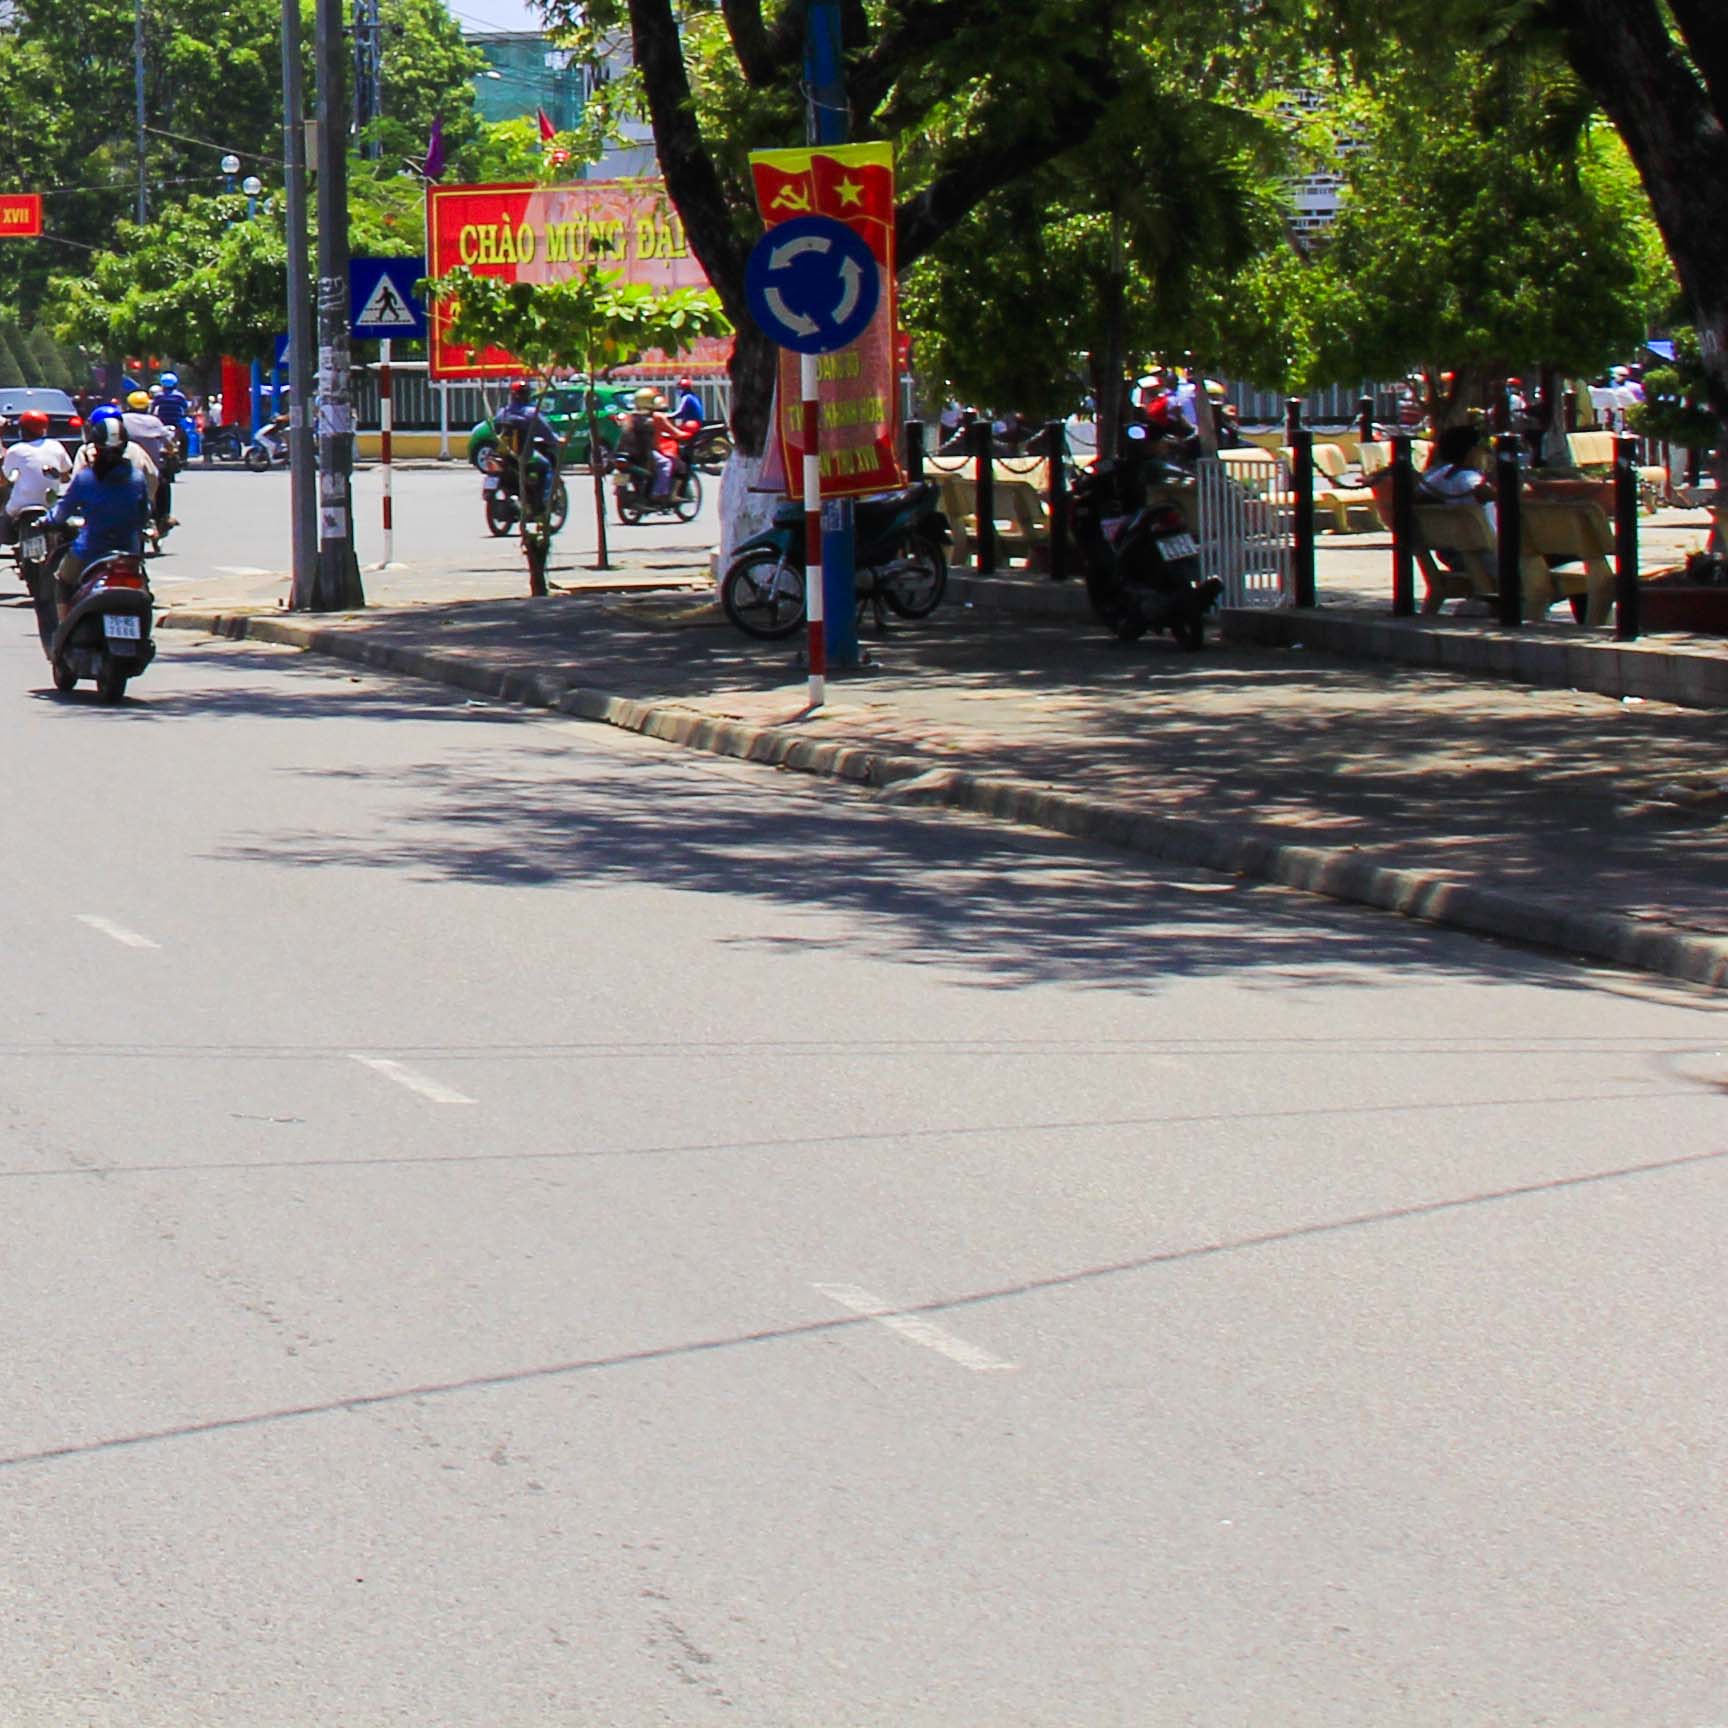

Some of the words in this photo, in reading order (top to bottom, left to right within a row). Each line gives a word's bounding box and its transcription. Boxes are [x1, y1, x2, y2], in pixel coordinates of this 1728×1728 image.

[3, 208, 29, 224] XVII
[459, 213, 535, 265] CHÀO
[546, 212, 628, 263] MỪNG
